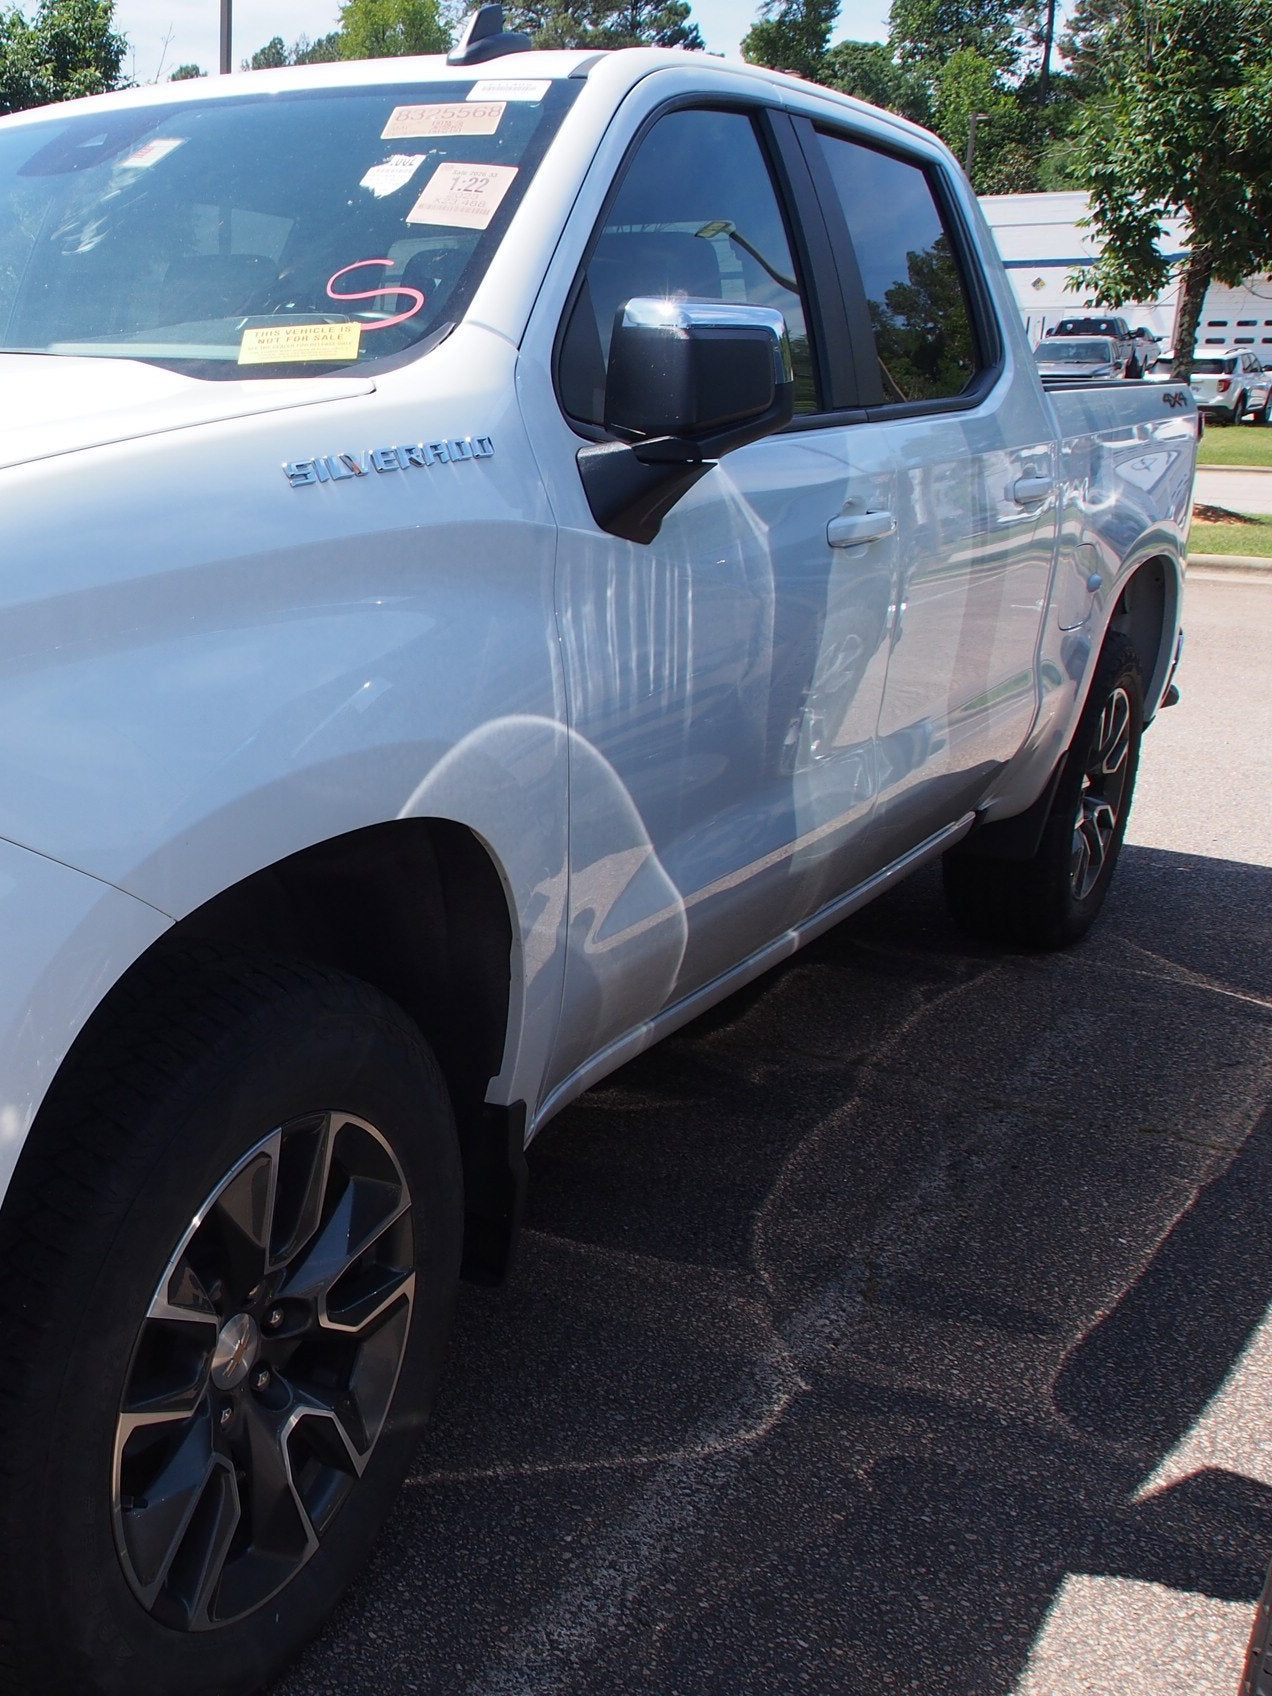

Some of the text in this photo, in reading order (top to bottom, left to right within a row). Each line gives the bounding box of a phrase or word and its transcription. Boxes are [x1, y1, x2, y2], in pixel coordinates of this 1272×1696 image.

[395, 106, 503, 122] 8325568
[449, 176, 490, 193] 1:22
[255, 329, 281, 338] THIS
[285, 327, 336, 336] VEHICLE
[257, 333, 344, 345] NOT FOR SALE
[1162, 391, 1188, 408] 4X4
[281, 434, 496, 488] SILVERADO
